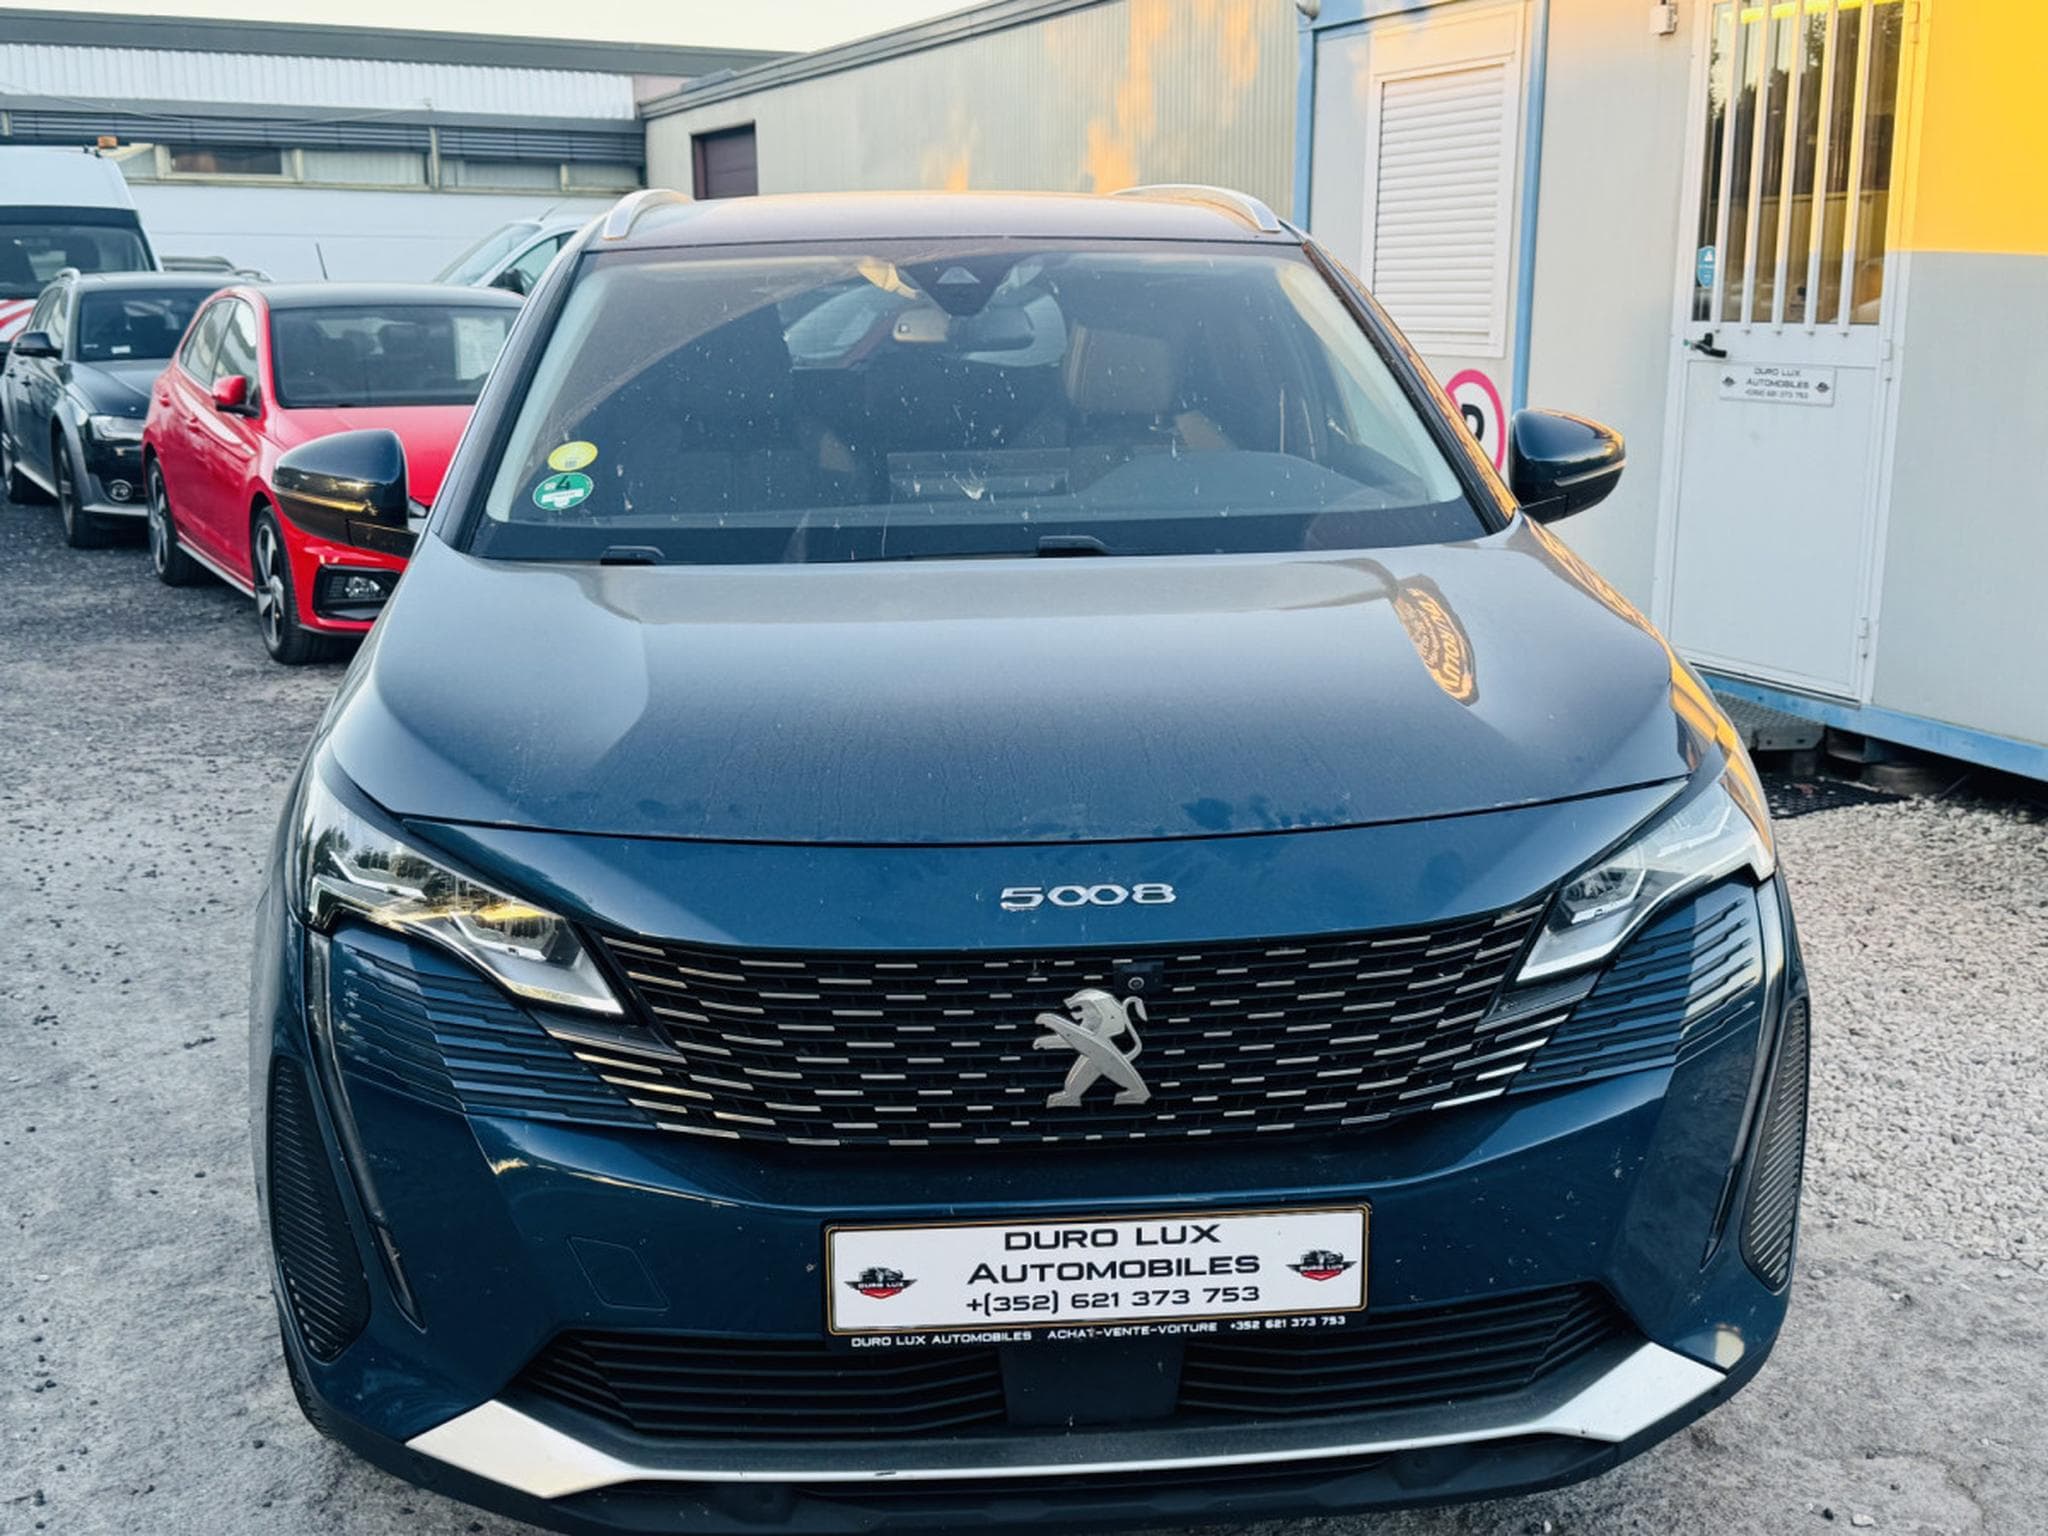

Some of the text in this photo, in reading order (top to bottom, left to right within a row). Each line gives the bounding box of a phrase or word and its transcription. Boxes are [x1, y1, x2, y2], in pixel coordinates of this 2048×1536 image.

[1000, 883, 1177, 909] 5008
[1004, 1224, 1222, 1251] DURO LUX
[967, 1255, 1261, 1285] AUTOMOBILES
[966, 1286, 1261, 1317] +(352) 621 373 753
[851, 1335, 892, 1348] DURO
[895, 1334, 926, 1346] LUX
[931, 1330, 1033, 1345] AUTOMOBILES
[1047, 1322, 1218, 1340] ACHAT-VENTE-VOITURE
[1265, 1318, 1287, 1330] 621
[1291, 1316, 1317, 1328] 373
[1321, 1315, 1346, 1326] 753
